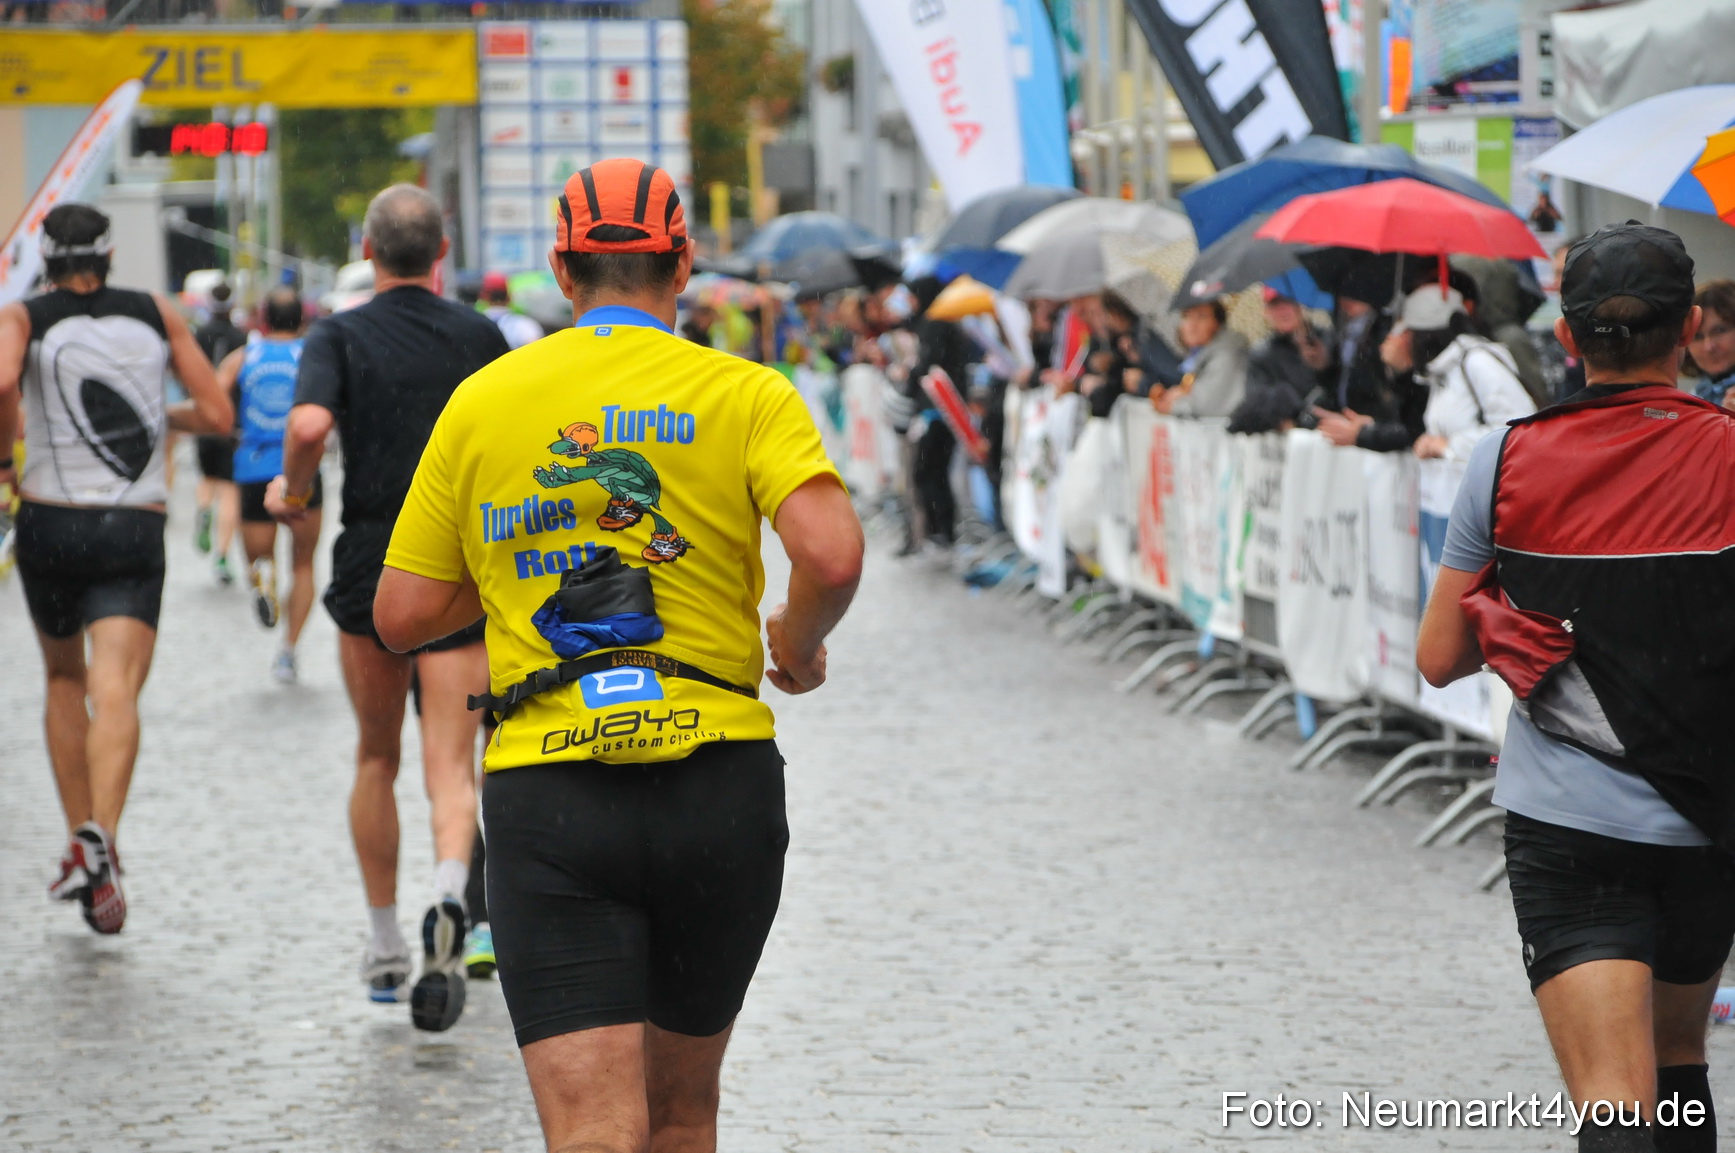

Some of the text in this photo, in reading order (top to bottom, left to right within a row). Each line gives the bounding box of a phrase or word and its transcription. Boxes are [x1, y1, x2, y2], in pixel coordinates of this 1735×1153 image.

[139, 47, 261, 91] ZIEL
[601, 404, 695, 445] Turbo
[479, 494, 577, 544] Turtles
[541, 708, 700, 755] owayo
[591, 736, 664, 755] custom
